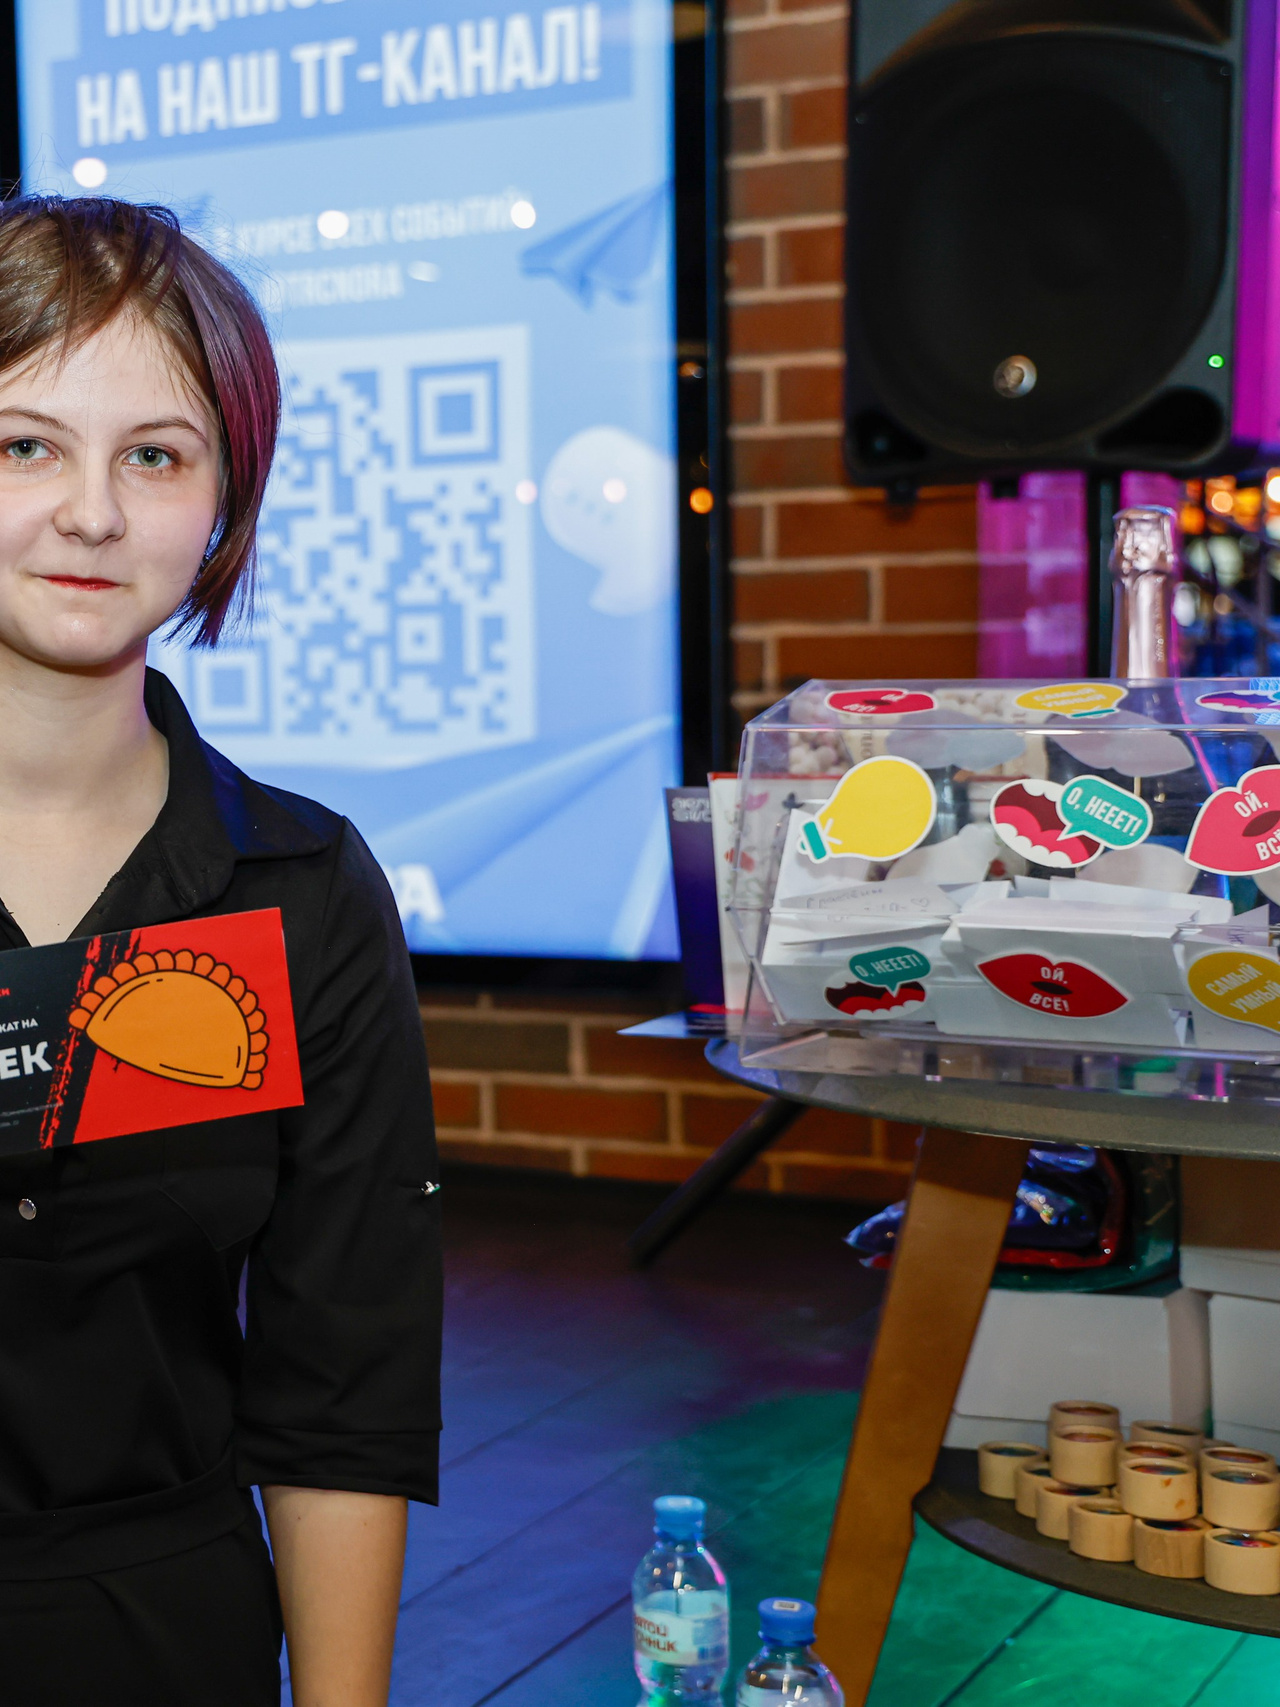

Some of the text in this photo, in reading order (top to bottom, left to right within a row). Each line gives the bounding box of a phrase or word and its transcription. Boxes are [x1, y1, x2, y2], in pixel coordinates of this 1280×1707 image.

[76, 2, 602, 148] НА НАШ ТГ-КАНАЛ!
[1083, 795, 1144, 837] НЕЕЕТ!
[1233, 789, 1270, 818] ОЙ,
[1205, 962, 1263, 996] САМЫЙ
[21, 1017, 39, 1030] НА
